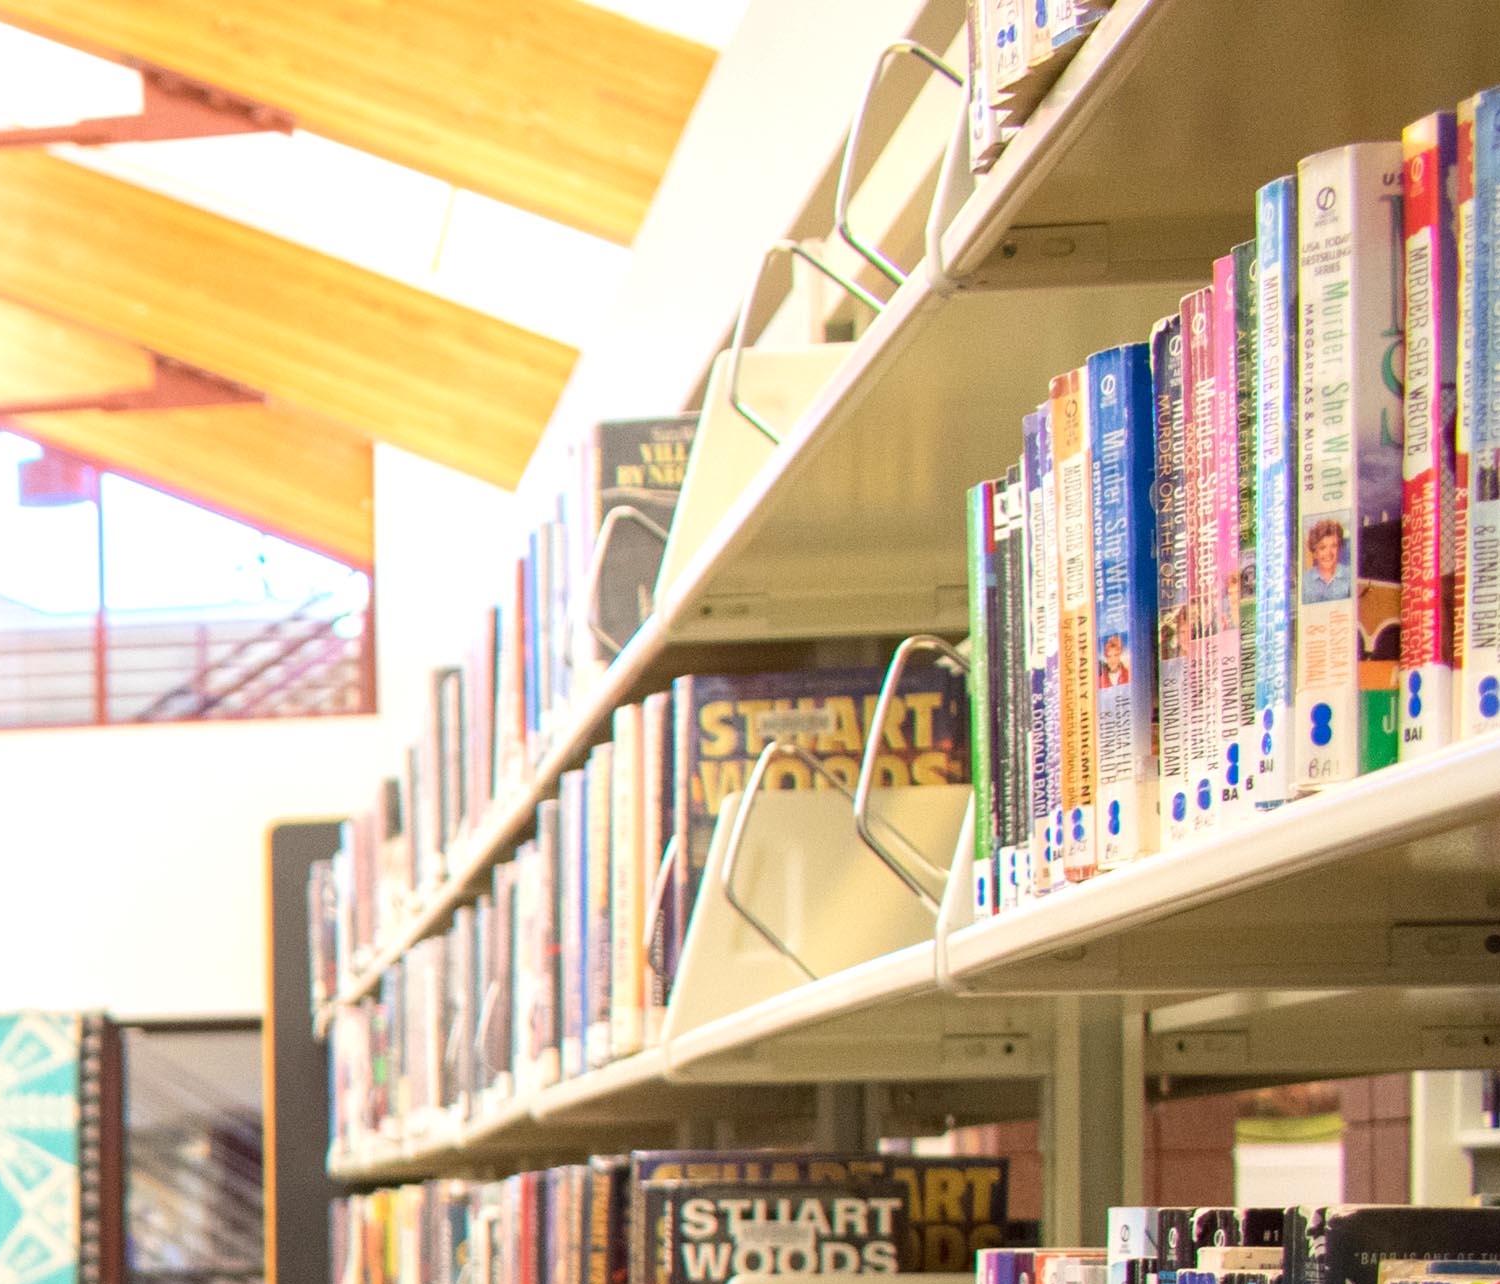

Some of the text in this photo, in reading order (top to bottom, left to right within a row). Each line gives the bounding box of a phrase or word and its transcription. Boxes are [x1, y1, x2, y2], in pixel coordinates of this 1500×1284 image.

[1303, 303, 1316, 493] MARGARITAS MURDER
[1320, 381, 1351, 503] She Wrote
[1406, 337, 1430, 458] SHE WROTE
[1157, 394, 1173, 557] MURDER ON THE
[1092, 461, 1104, 603] DESTINATION MURDER
[1101, 520, 1129, 623] She Wrote
[1410, 492, 1424, 580] JESSICA
[1421, 481, 1436, 581] MARTINIS
[1471, 540, 1499, 650] DONALD BAIN
[700, 692, 942, 756] STUART
[699, 752, 961, 816] WOODS
[680, 1197, 903, 1241] STUART
[680, 1240, 900, 1282] WOODS
